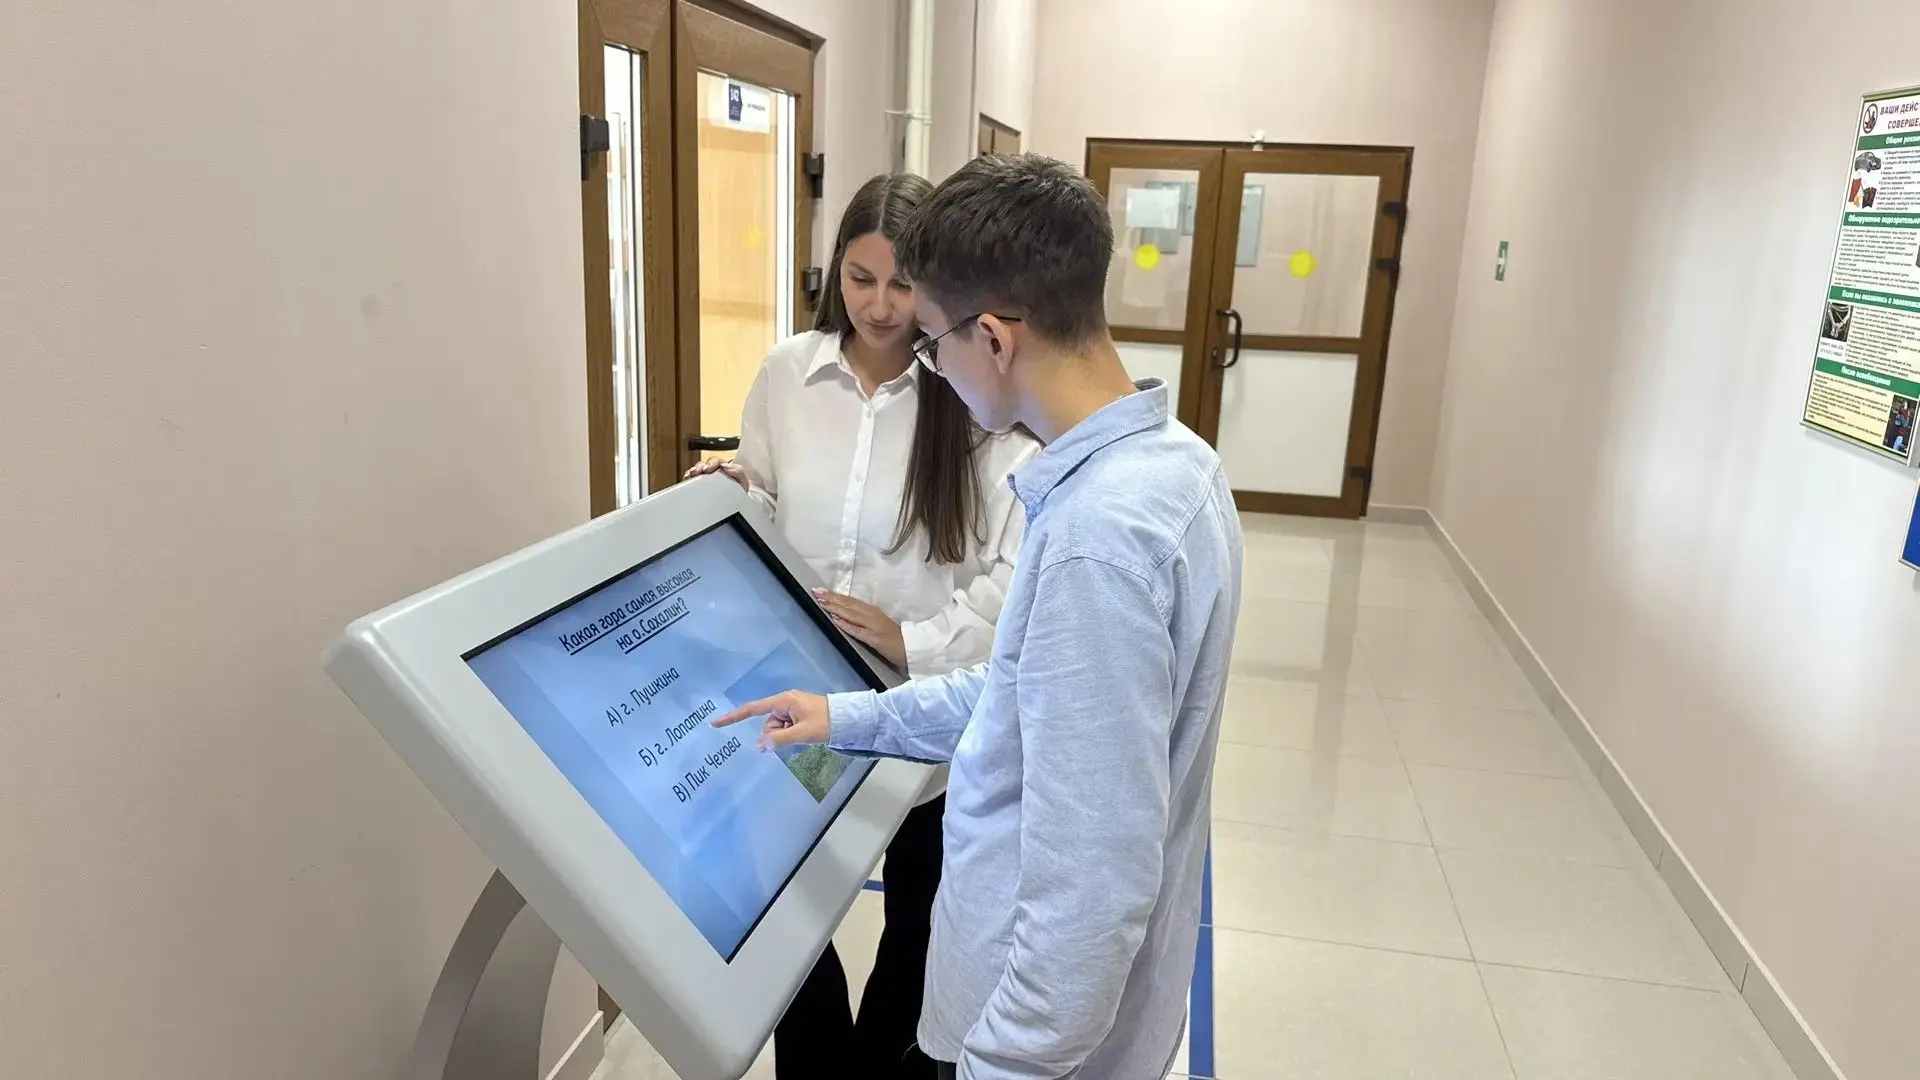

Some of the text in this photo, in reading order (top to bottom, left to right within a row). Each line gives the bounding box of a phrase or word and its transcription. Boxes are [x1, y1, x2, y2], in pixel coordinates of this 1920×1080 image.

[1880, 101, 1920, 115] ВАШИ ДЕЙС
[1888, 117, 1920, 129] СОВЕРШЕ
[558, 568, 696, 652] Какая гора самая высокая
[616, 597, 688, 650] на о.Сахалин?
[606, 706, 624, 727] А)
[630, 667, 680, 705] Пушкина
[638, 747, 658, 767] Б)
[665, 699, 717, 746] Лопатина
[672, 736, 741, 802] В) Пик Чехова
